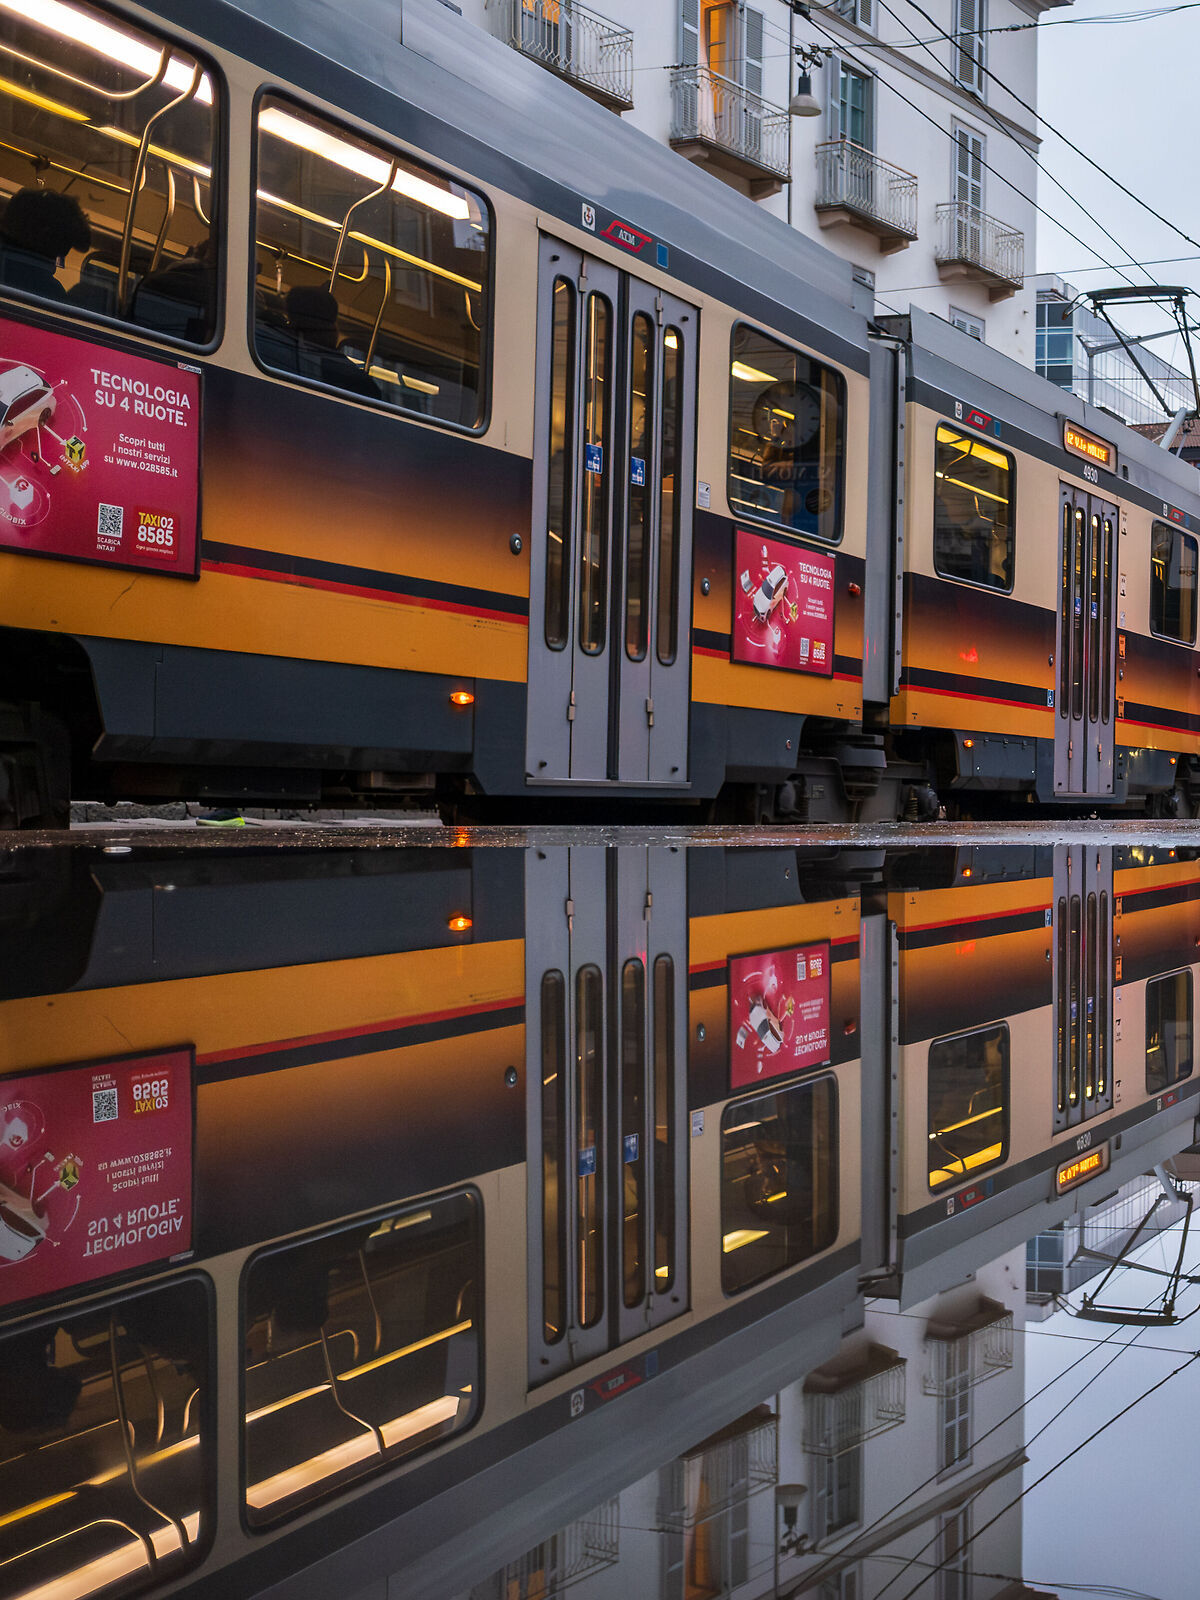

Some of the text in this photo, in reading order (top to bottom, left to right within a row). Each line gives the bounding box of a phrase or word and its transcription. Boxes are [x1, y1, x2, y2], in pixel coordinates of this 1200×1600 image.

[618, 229, 636, 246] ATM
[90, 368, 191, 409] TECNOLOGIA
[94, 389, 188, 427] SU 4 RUOTE.
[118, 433, 166, 452] Scopri tutti
[1067, 432, 1074, 445] 12
[118, 446, 143, 460] nostri
[144, 452, 171, 466] servizi
[104, 455, 179, 479] su www.028585.it
[97, 536, 121, 546] SCARICA
[137, 526, 174, 547] 8585
[96, 544, 116, 553] INTAXI
[799, 562, 832, 579] TECNOLOGIA
[800, 573, 808, 583] SU
